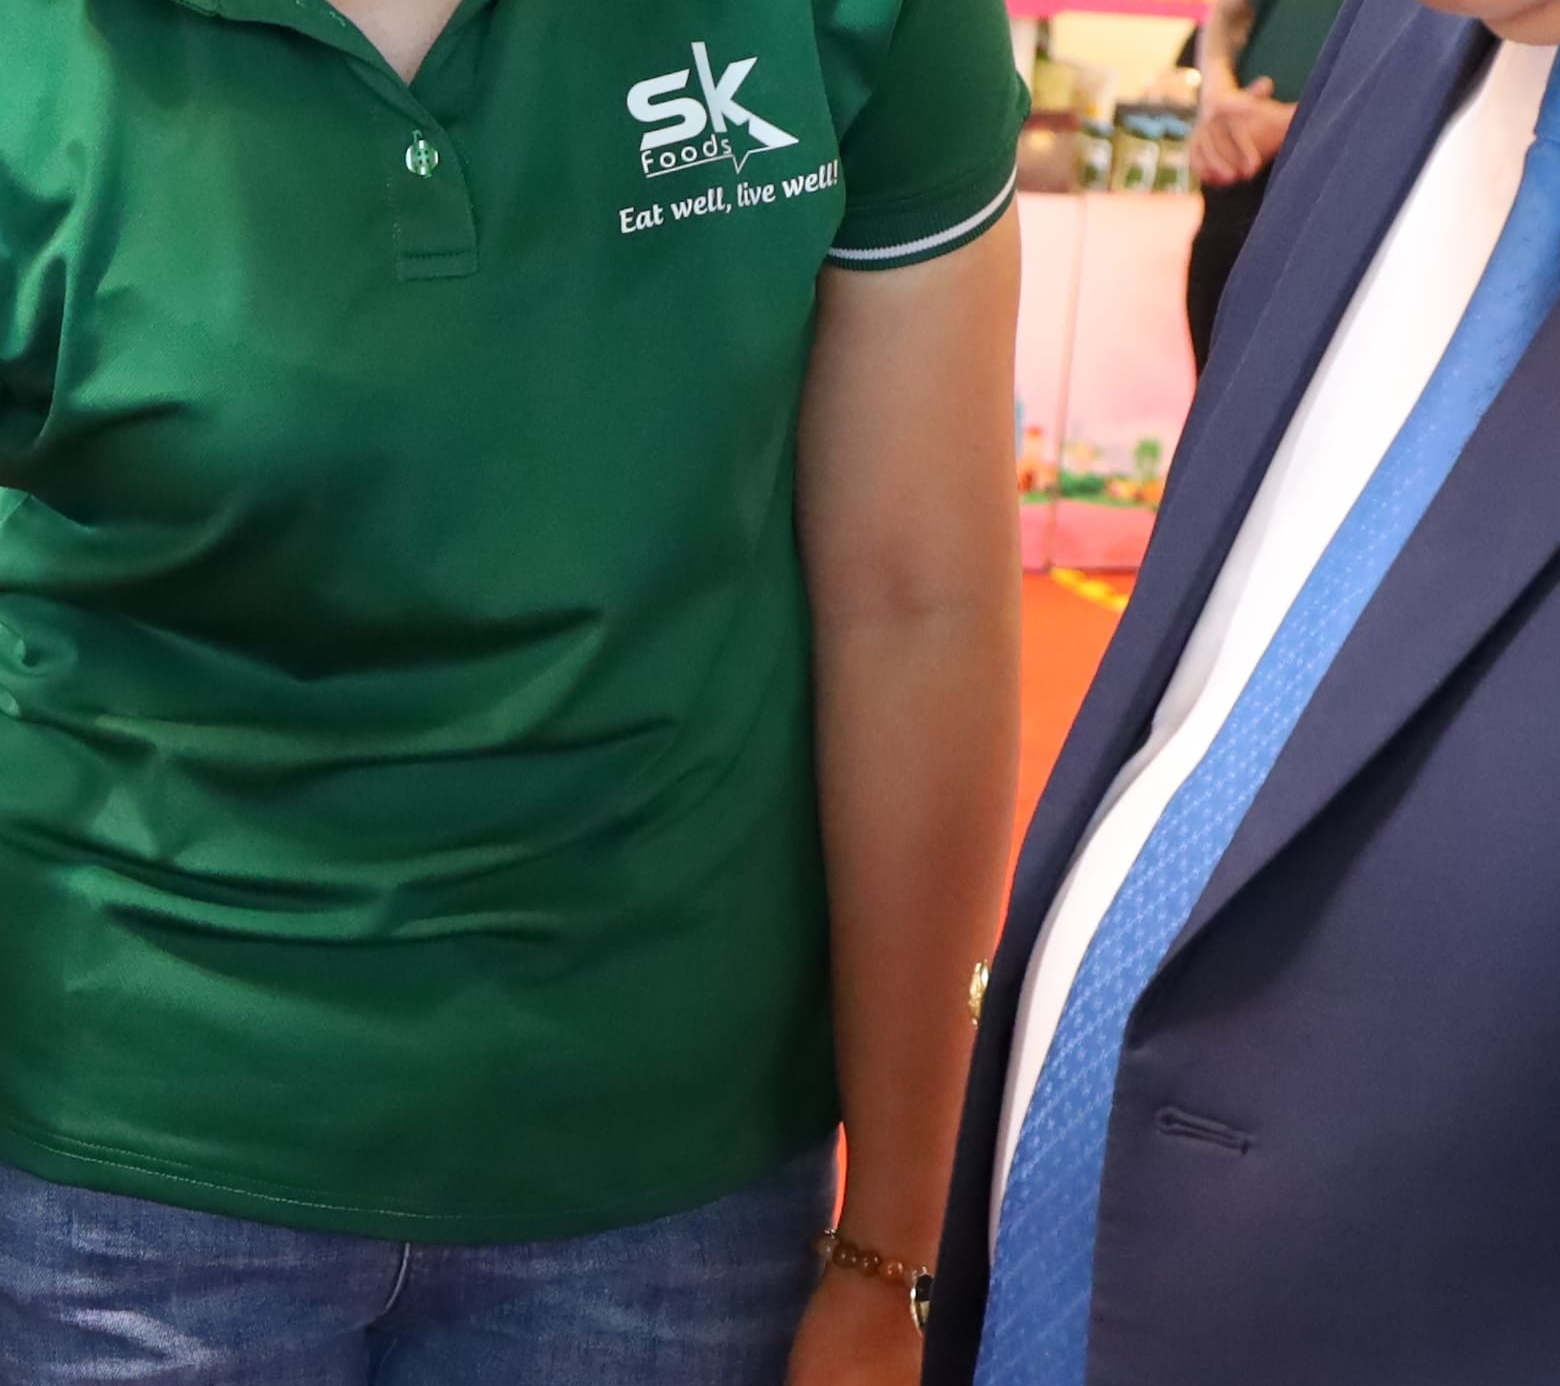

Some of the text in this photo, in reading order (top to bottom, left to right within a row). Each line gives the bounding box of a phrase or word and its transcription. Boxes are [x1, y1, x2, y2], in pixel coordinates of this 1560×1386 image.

[619, 159, 839, 234] Eat well, live well!
